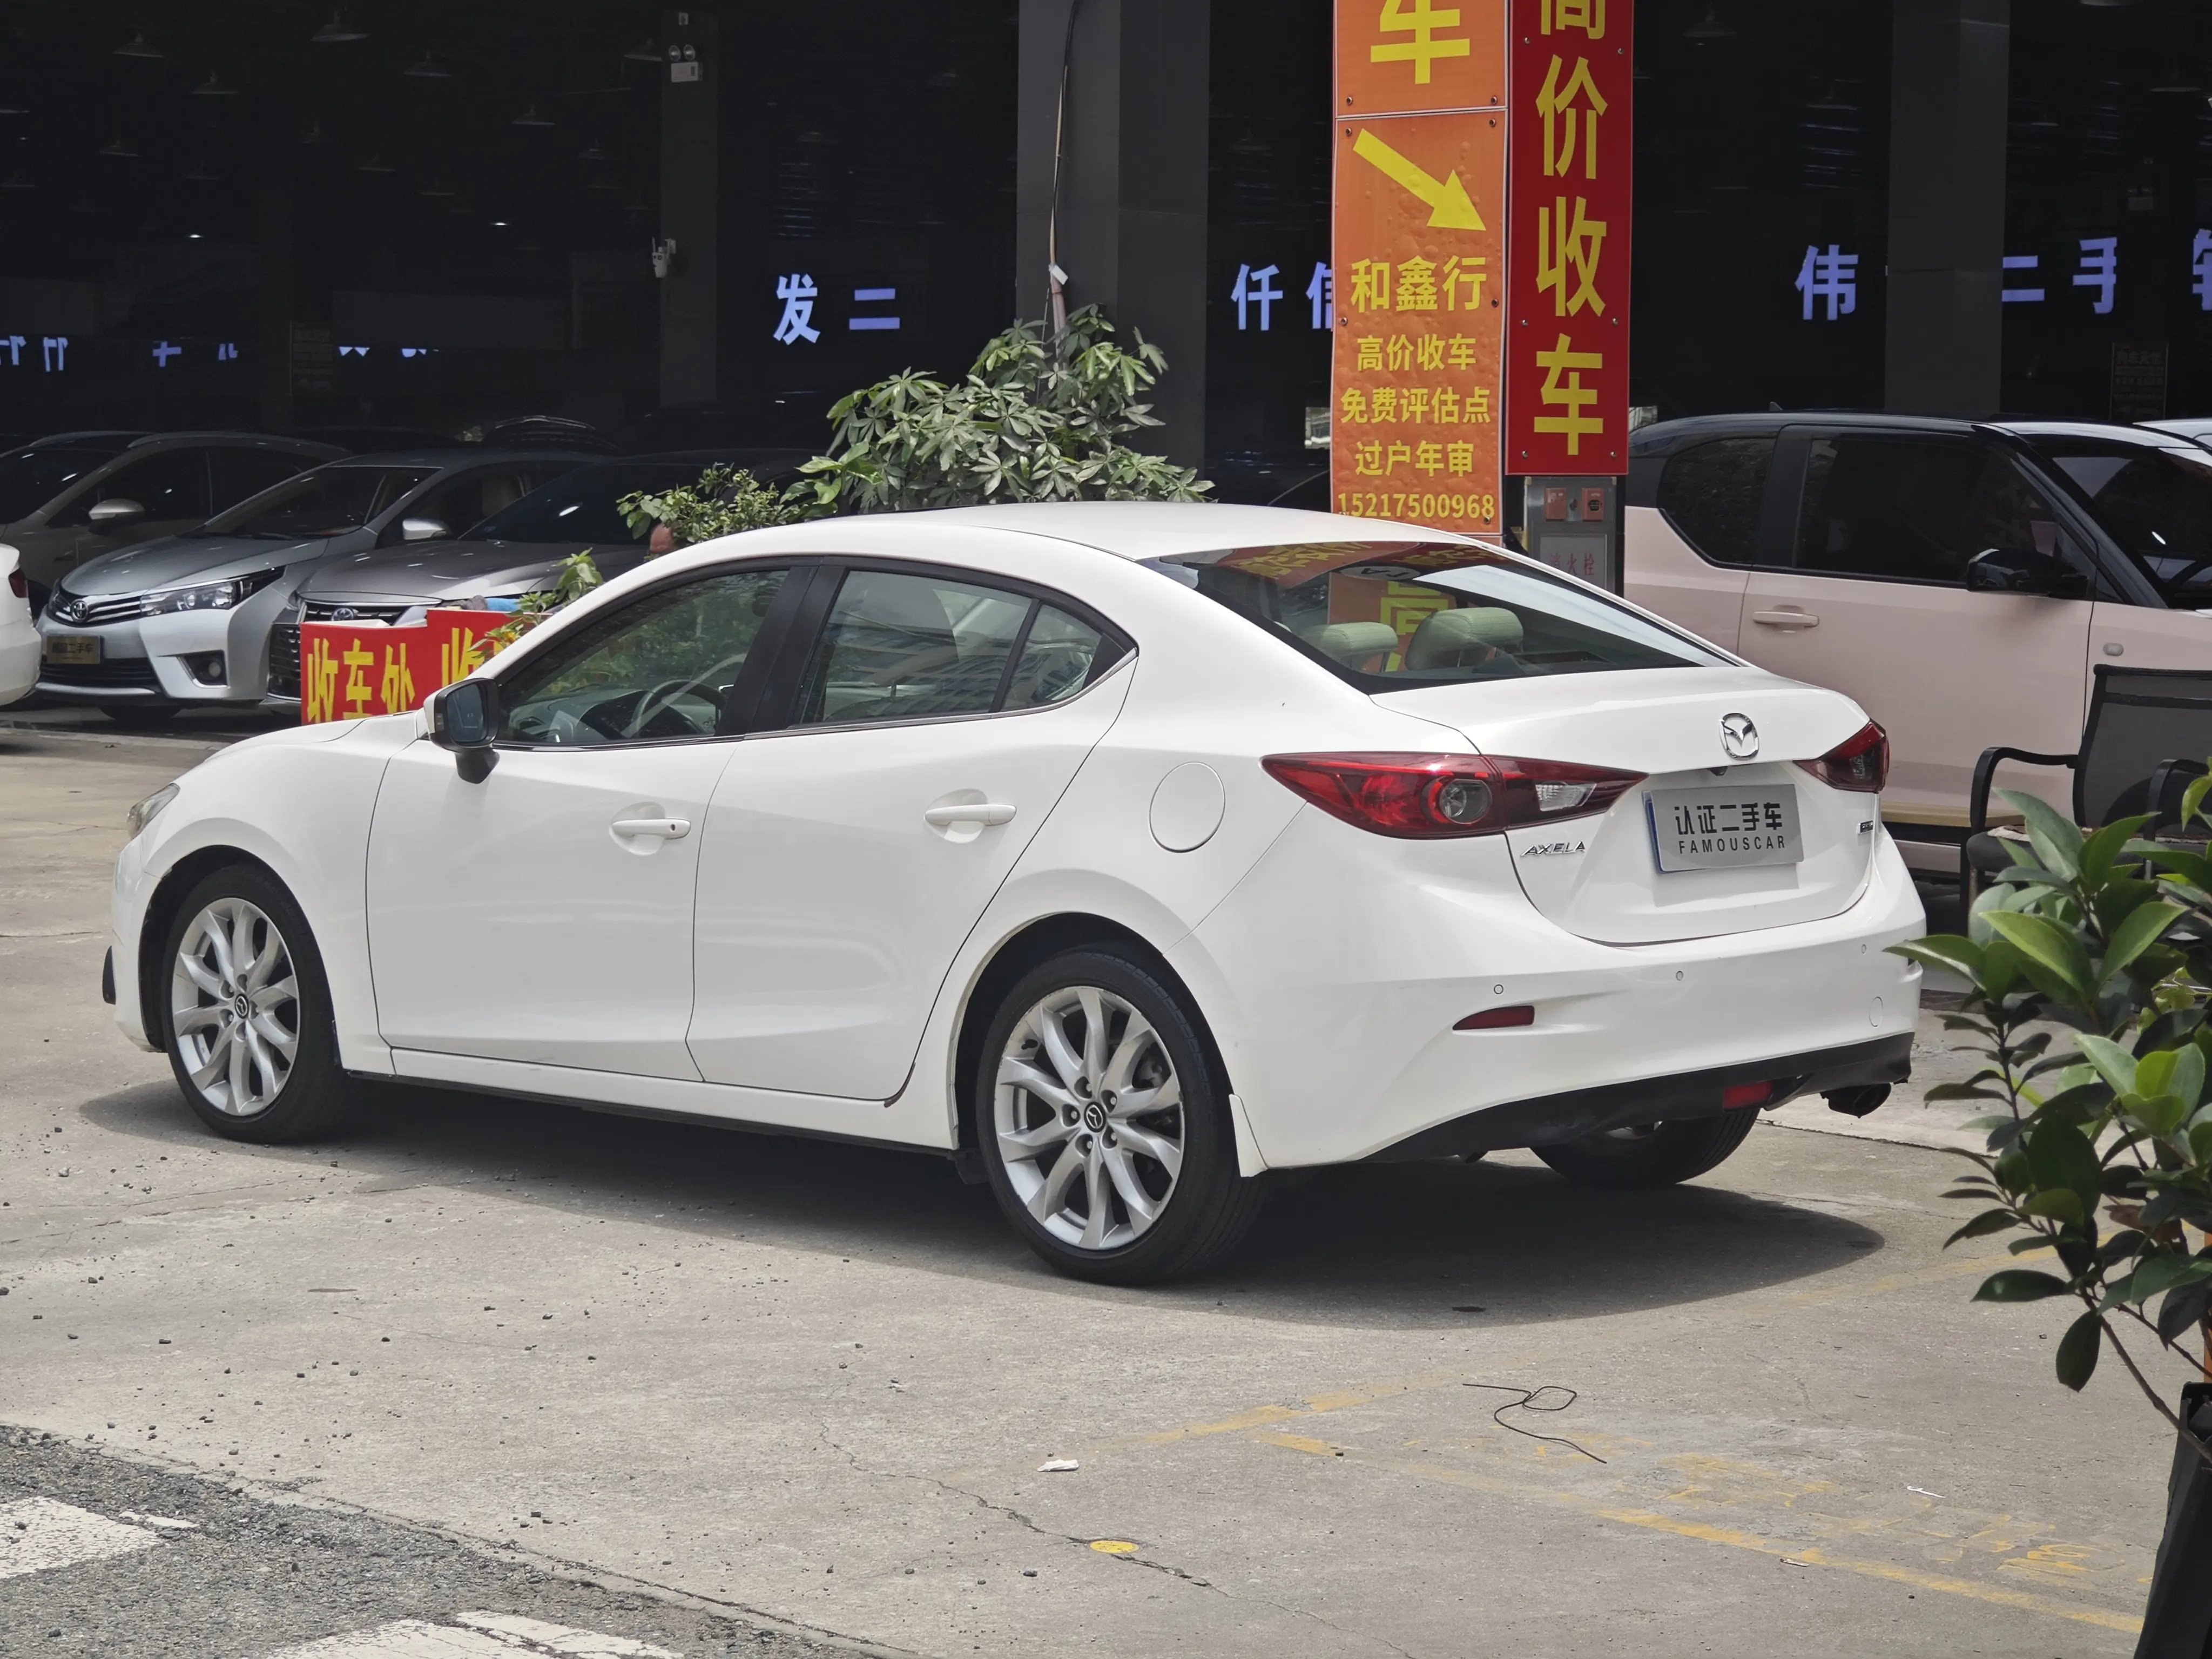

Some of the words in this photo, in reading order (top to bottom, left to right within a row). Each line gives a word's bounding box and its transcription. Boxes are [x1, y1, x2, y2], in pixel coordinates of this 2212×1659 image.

[1351, 255, 1487, 313] 和鑫行
[1795, 244, 1859, 320] 伟
[1357, 333, 1476, 372] 高价收车
[1340, 386, 1491, 425] 免费评估点
[1355, 439, 1475, 477] 过户年审
[1338, 493, 1495, 519] 15217500968
[1674, 802, 1783, 835] 认证二手车
[1520, 840, 1586, 857] AXELA
[1678, 835, 1785, 854] FAMOUSCAR
